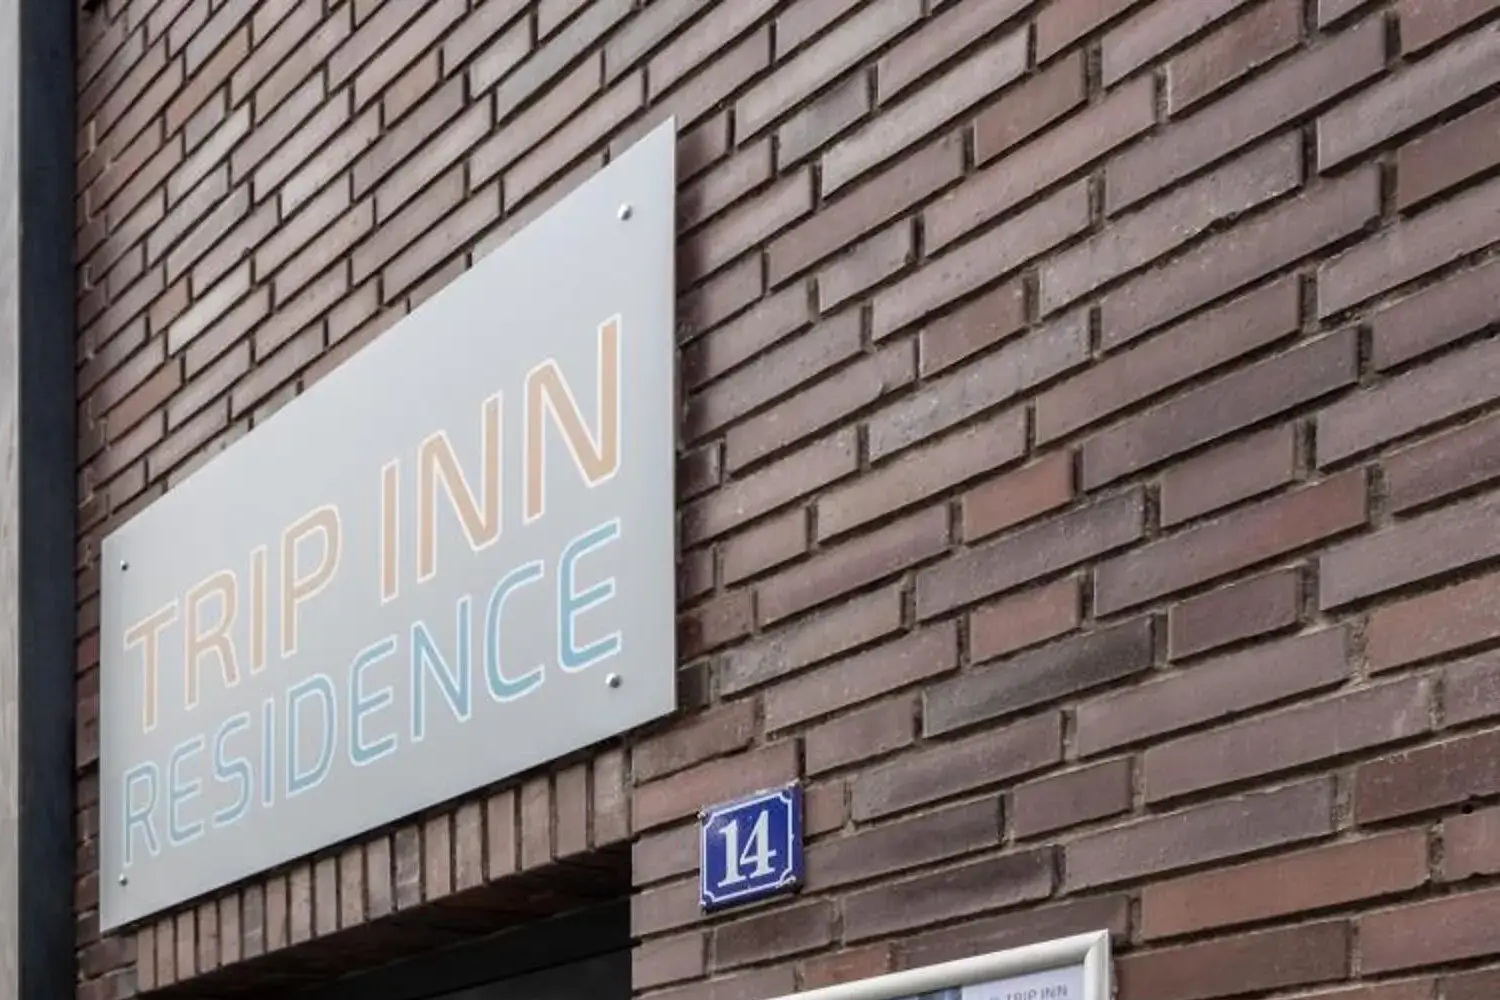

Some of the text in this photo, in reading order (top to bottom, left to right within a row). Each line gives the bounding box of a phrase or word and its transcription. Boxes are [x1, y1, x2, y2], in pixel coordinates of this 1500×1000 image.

[123, 312, 623, 734] TRIP INN
[122, 518, 623, 868] RESIDENCE
[717, 810, 777, 887] 14
[1041, 984, 1068, 1000] INN
